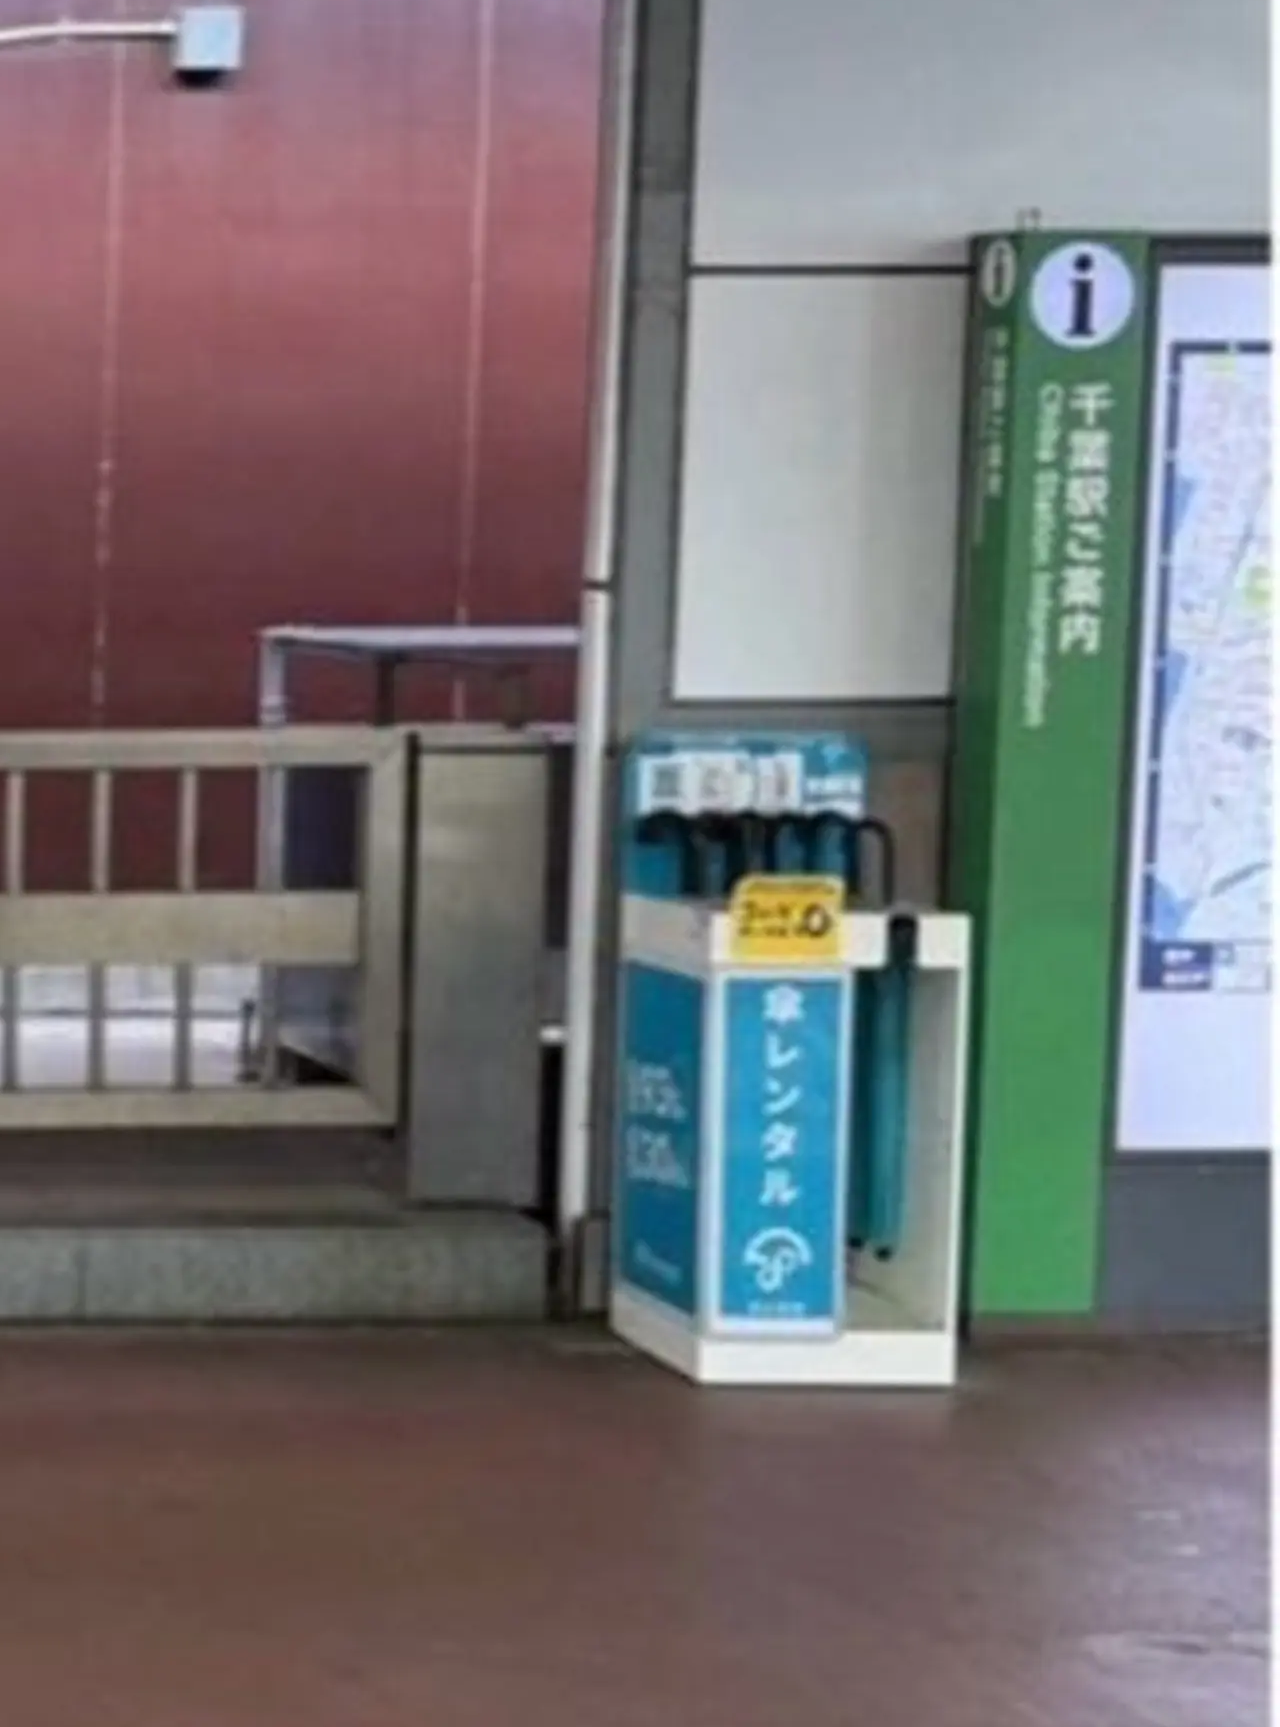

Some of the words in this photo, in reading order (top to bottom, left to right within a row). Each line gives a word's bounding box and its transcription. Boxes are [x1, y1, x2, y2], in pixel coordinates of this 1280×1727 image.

[1057, 382, 1115, 656] 千葉駅ご案内
[760, 984, 807, 1207] 傘レンタル
